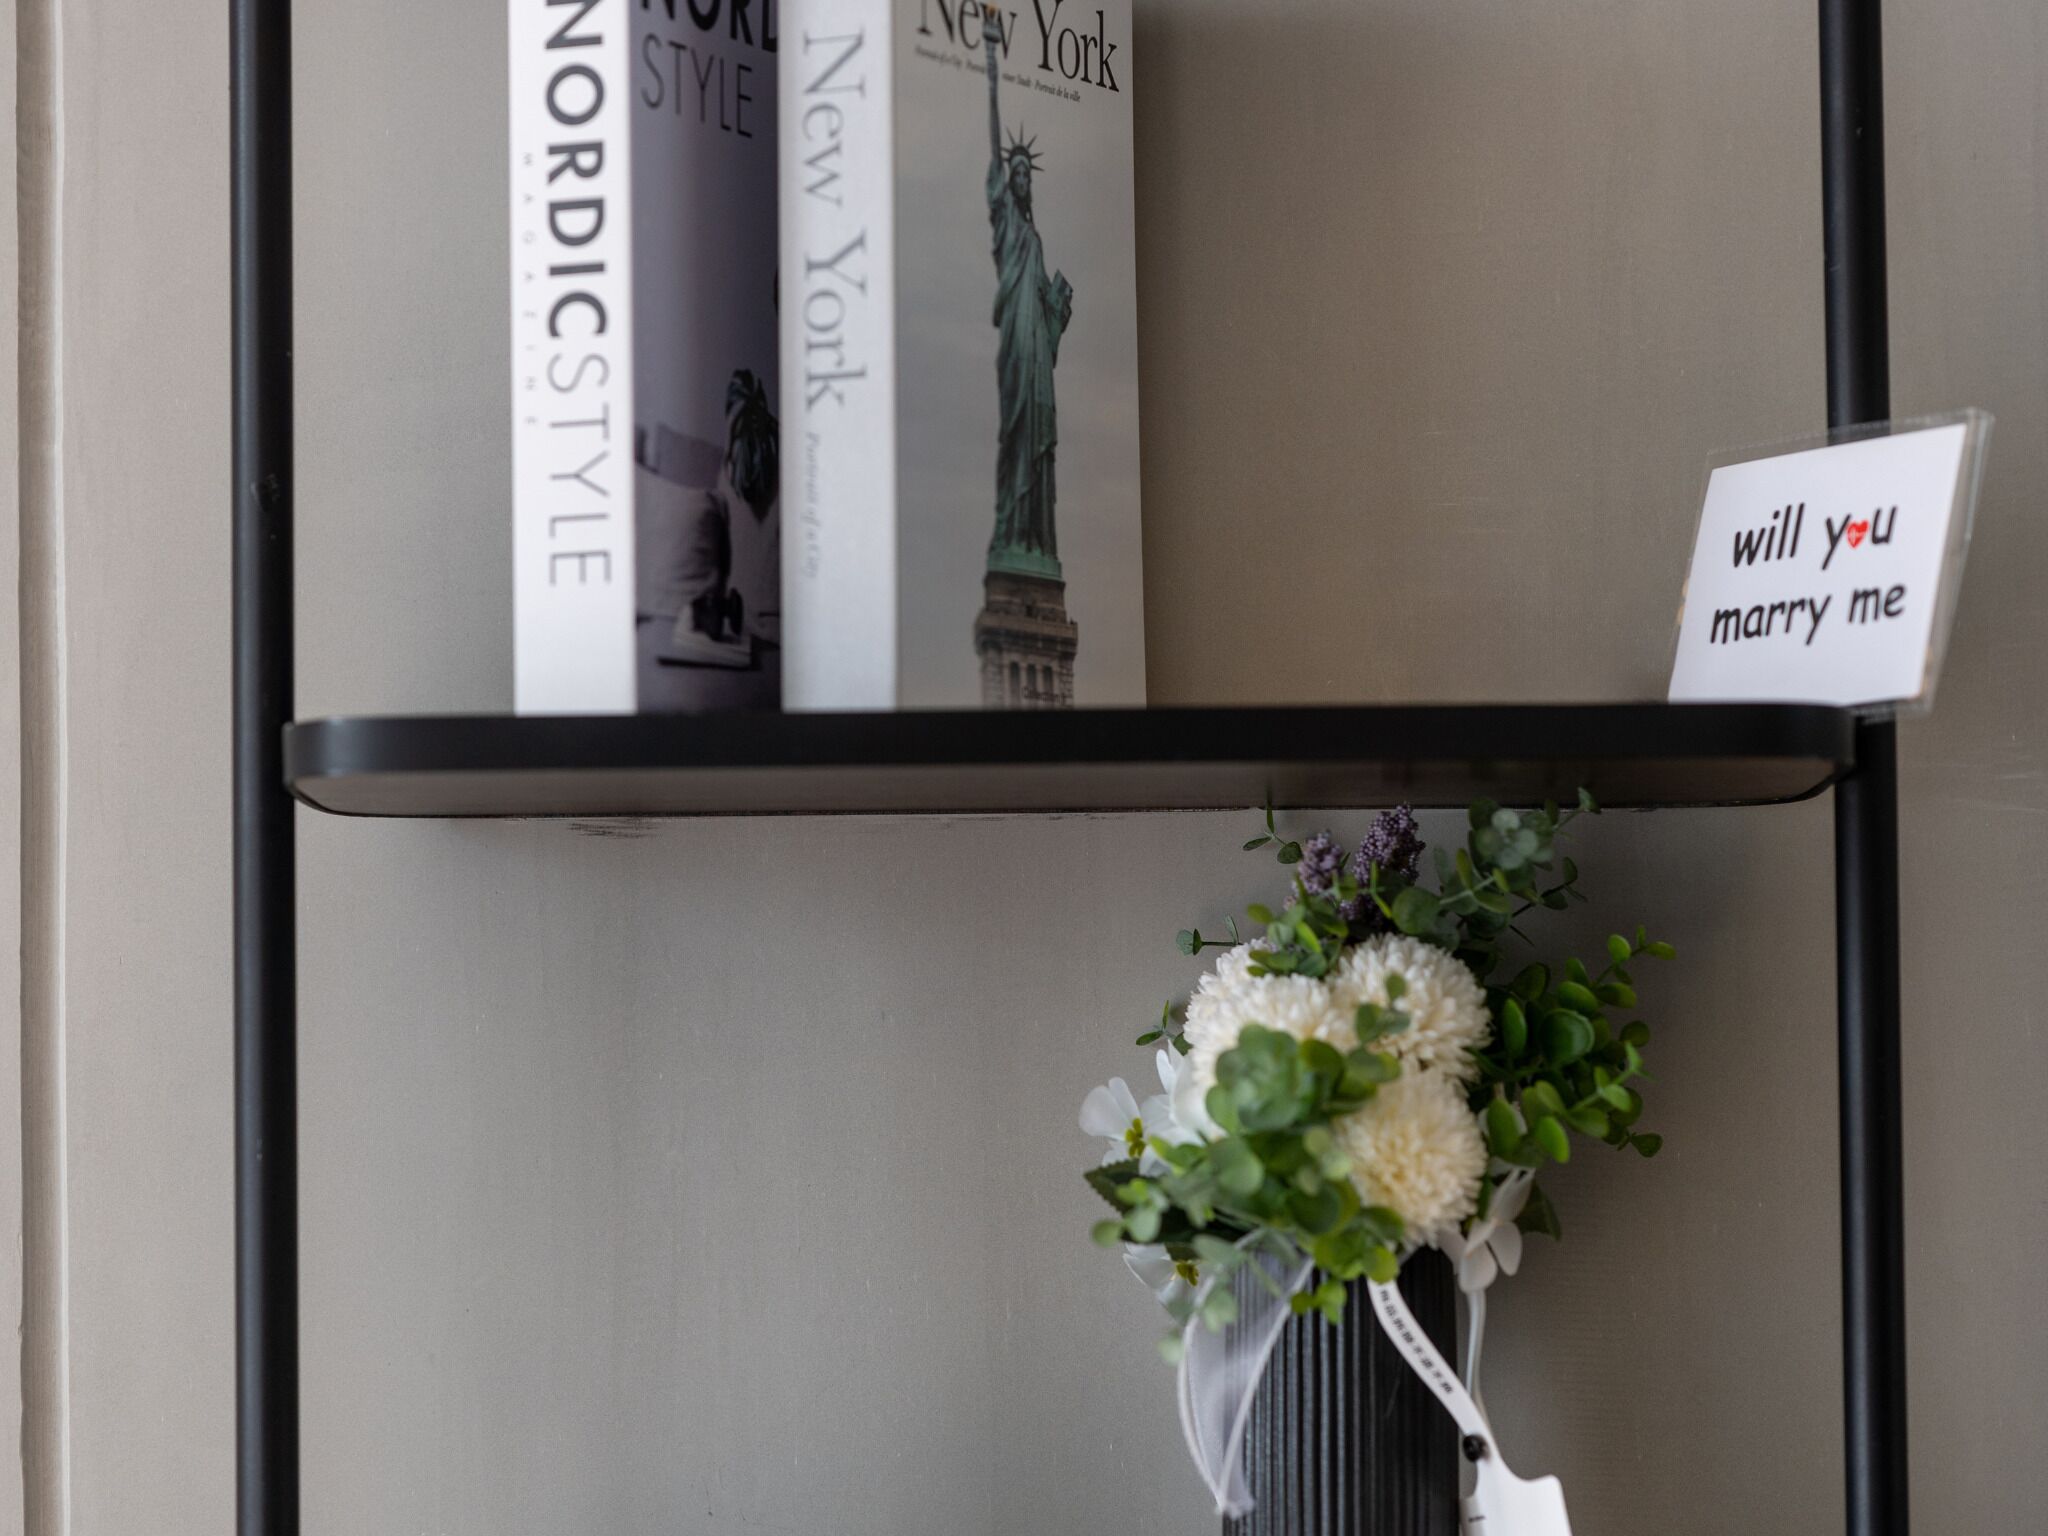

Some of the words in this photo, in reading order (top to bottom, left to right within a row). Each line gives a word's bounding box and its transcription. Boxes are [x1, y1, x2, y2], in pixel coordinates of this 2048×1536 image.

[641, 33, 753, 138] STYLE
[916, 0, 1018, 60] New
[1033, 0, 1120, 93] York
[802, 26, 866, 208] New
[804, 228, 868, 412] York
[1732, 502, 1806, 568] will
[1710, 594, 1832, 646] marry
[1848, 584, 1907, 625] me
